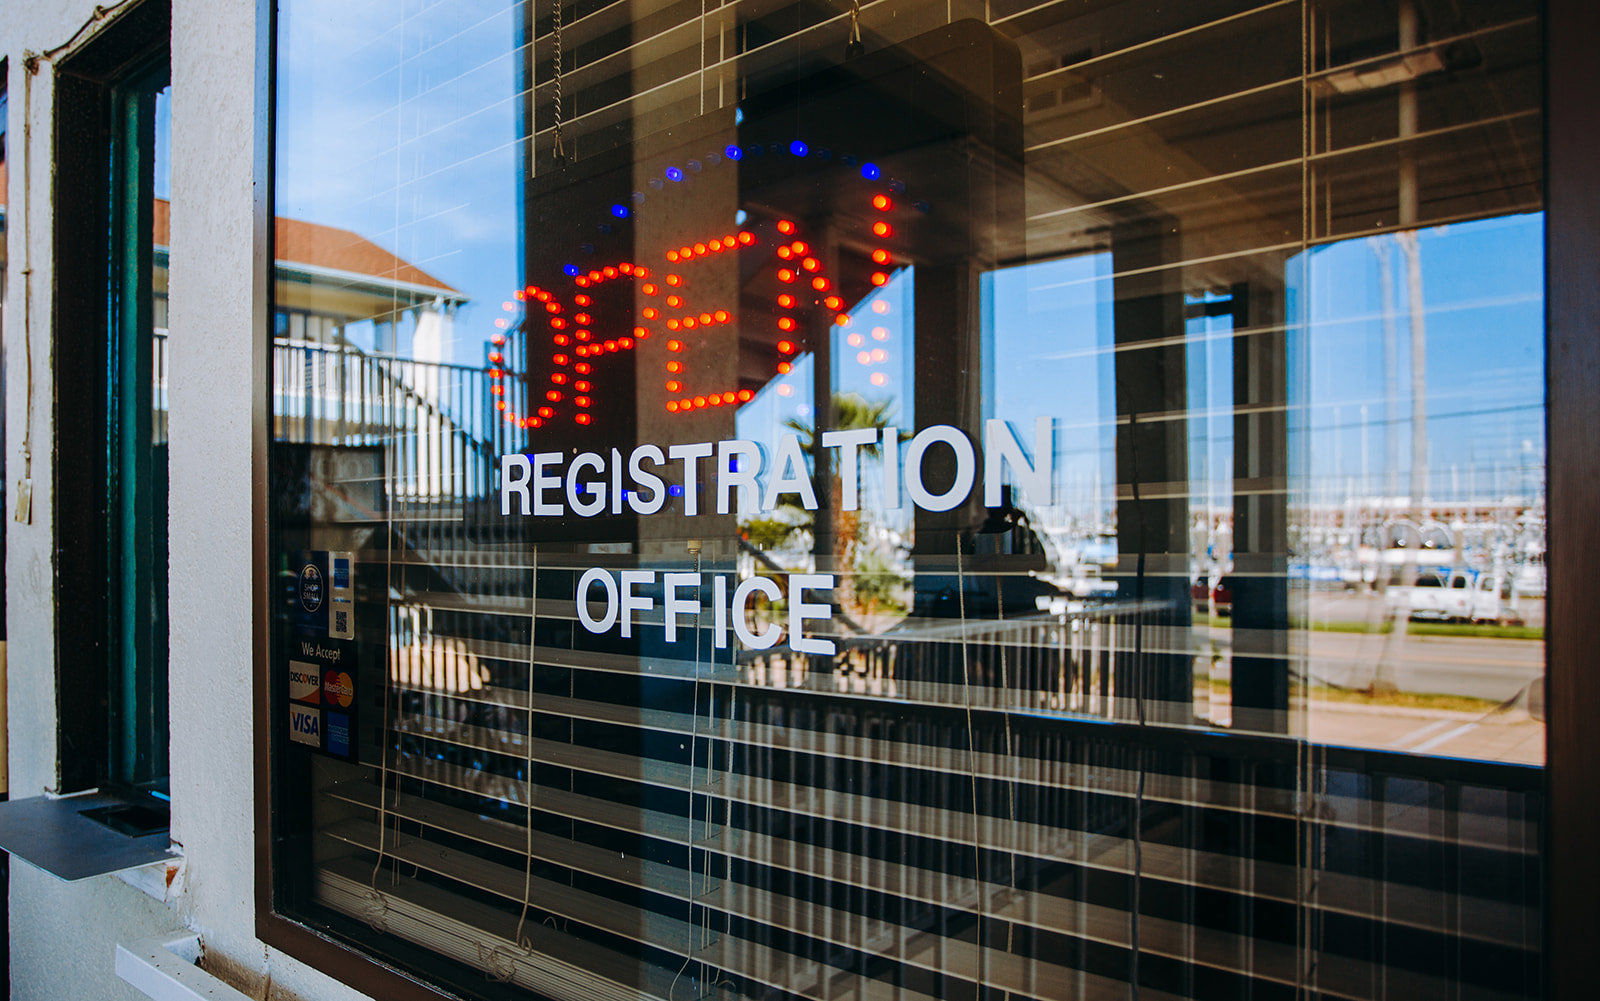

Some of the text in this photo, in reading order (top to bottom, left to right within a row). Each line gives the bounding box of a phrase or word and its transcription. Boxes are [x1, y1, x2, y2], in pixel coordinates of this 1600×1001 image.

[487, 191, 892, 428] OPEN
[501, 416, 1054, 517] REGISTRATION
[304, 583, 319, 592] SHOP
[576, 567, 836, 655] OFFICE
[301, 641, 341, 664] We Accept
[290, 671, 319, 687] DISCOVER
[291, 712, 319, 737] VISA
